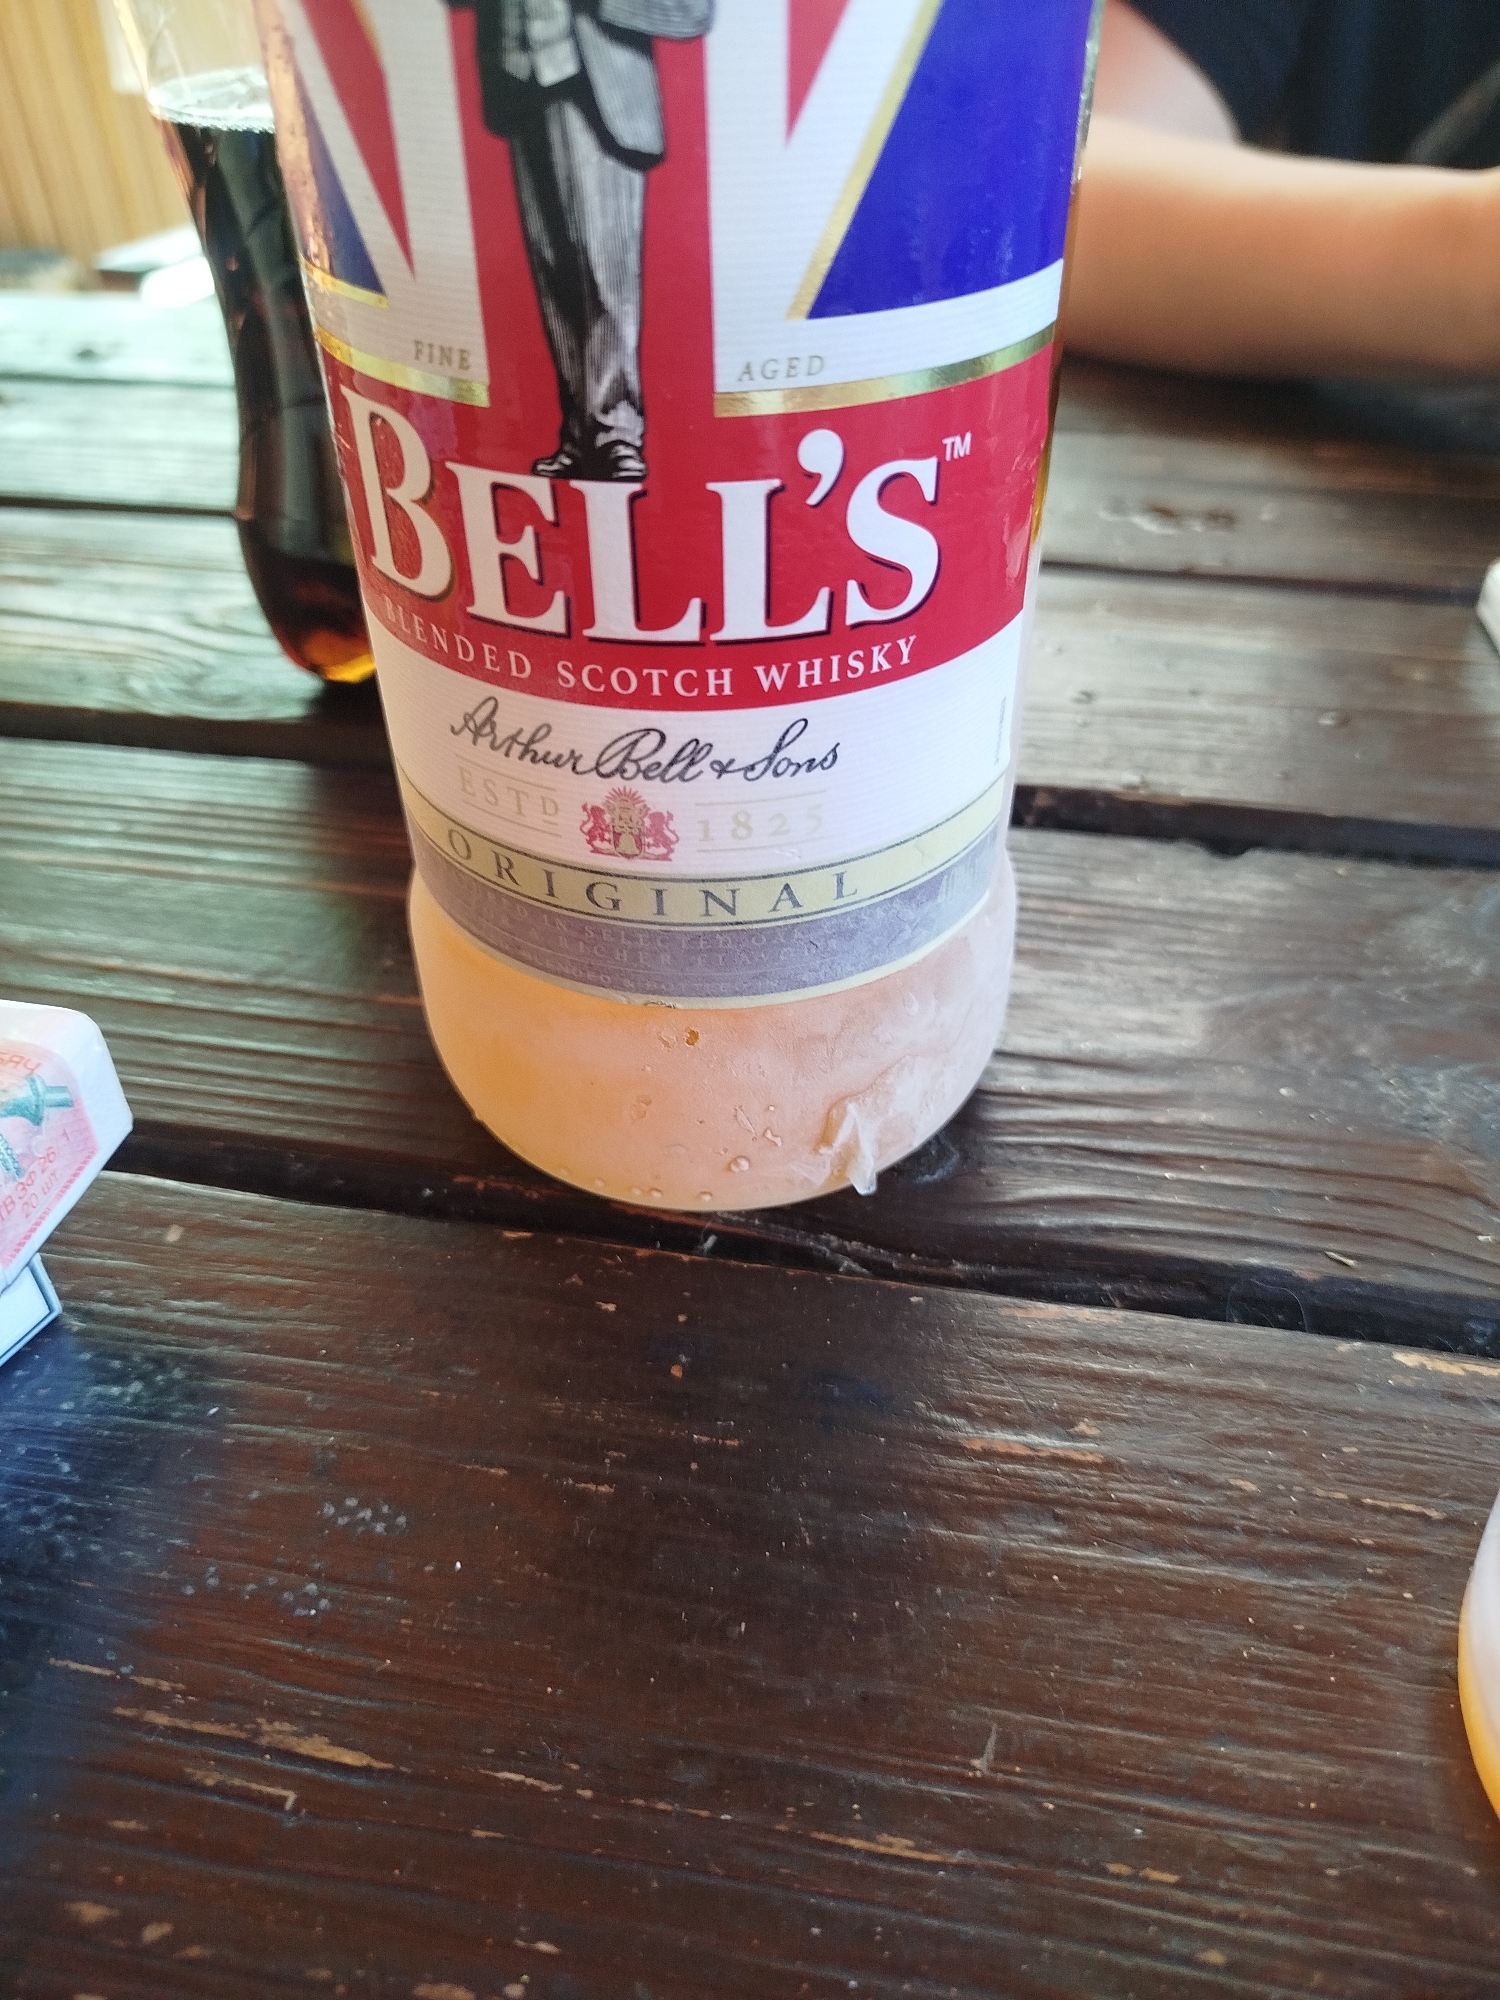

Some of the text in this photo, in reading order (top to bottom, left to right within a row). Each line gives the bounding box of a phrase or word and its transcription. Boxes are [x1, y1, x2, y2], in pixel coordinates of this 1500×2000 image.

[413, 340, 472, 372] FINE
[737, 353, 827, 383] AGED
[339, 384, 942, 645] BELL'S
[383, 593, 919, 699] BLENDED SCOTCH WHISKY
[450, 696, 586, 775] Arthur
[588, 727, 714, 783] Bell
[732, 717, 841, 783] Sons
[457, 764, 561, 826] ESTD
[697, 803, 826, 843] 1825
[447, 827, 859, 918] ORIGINAL
